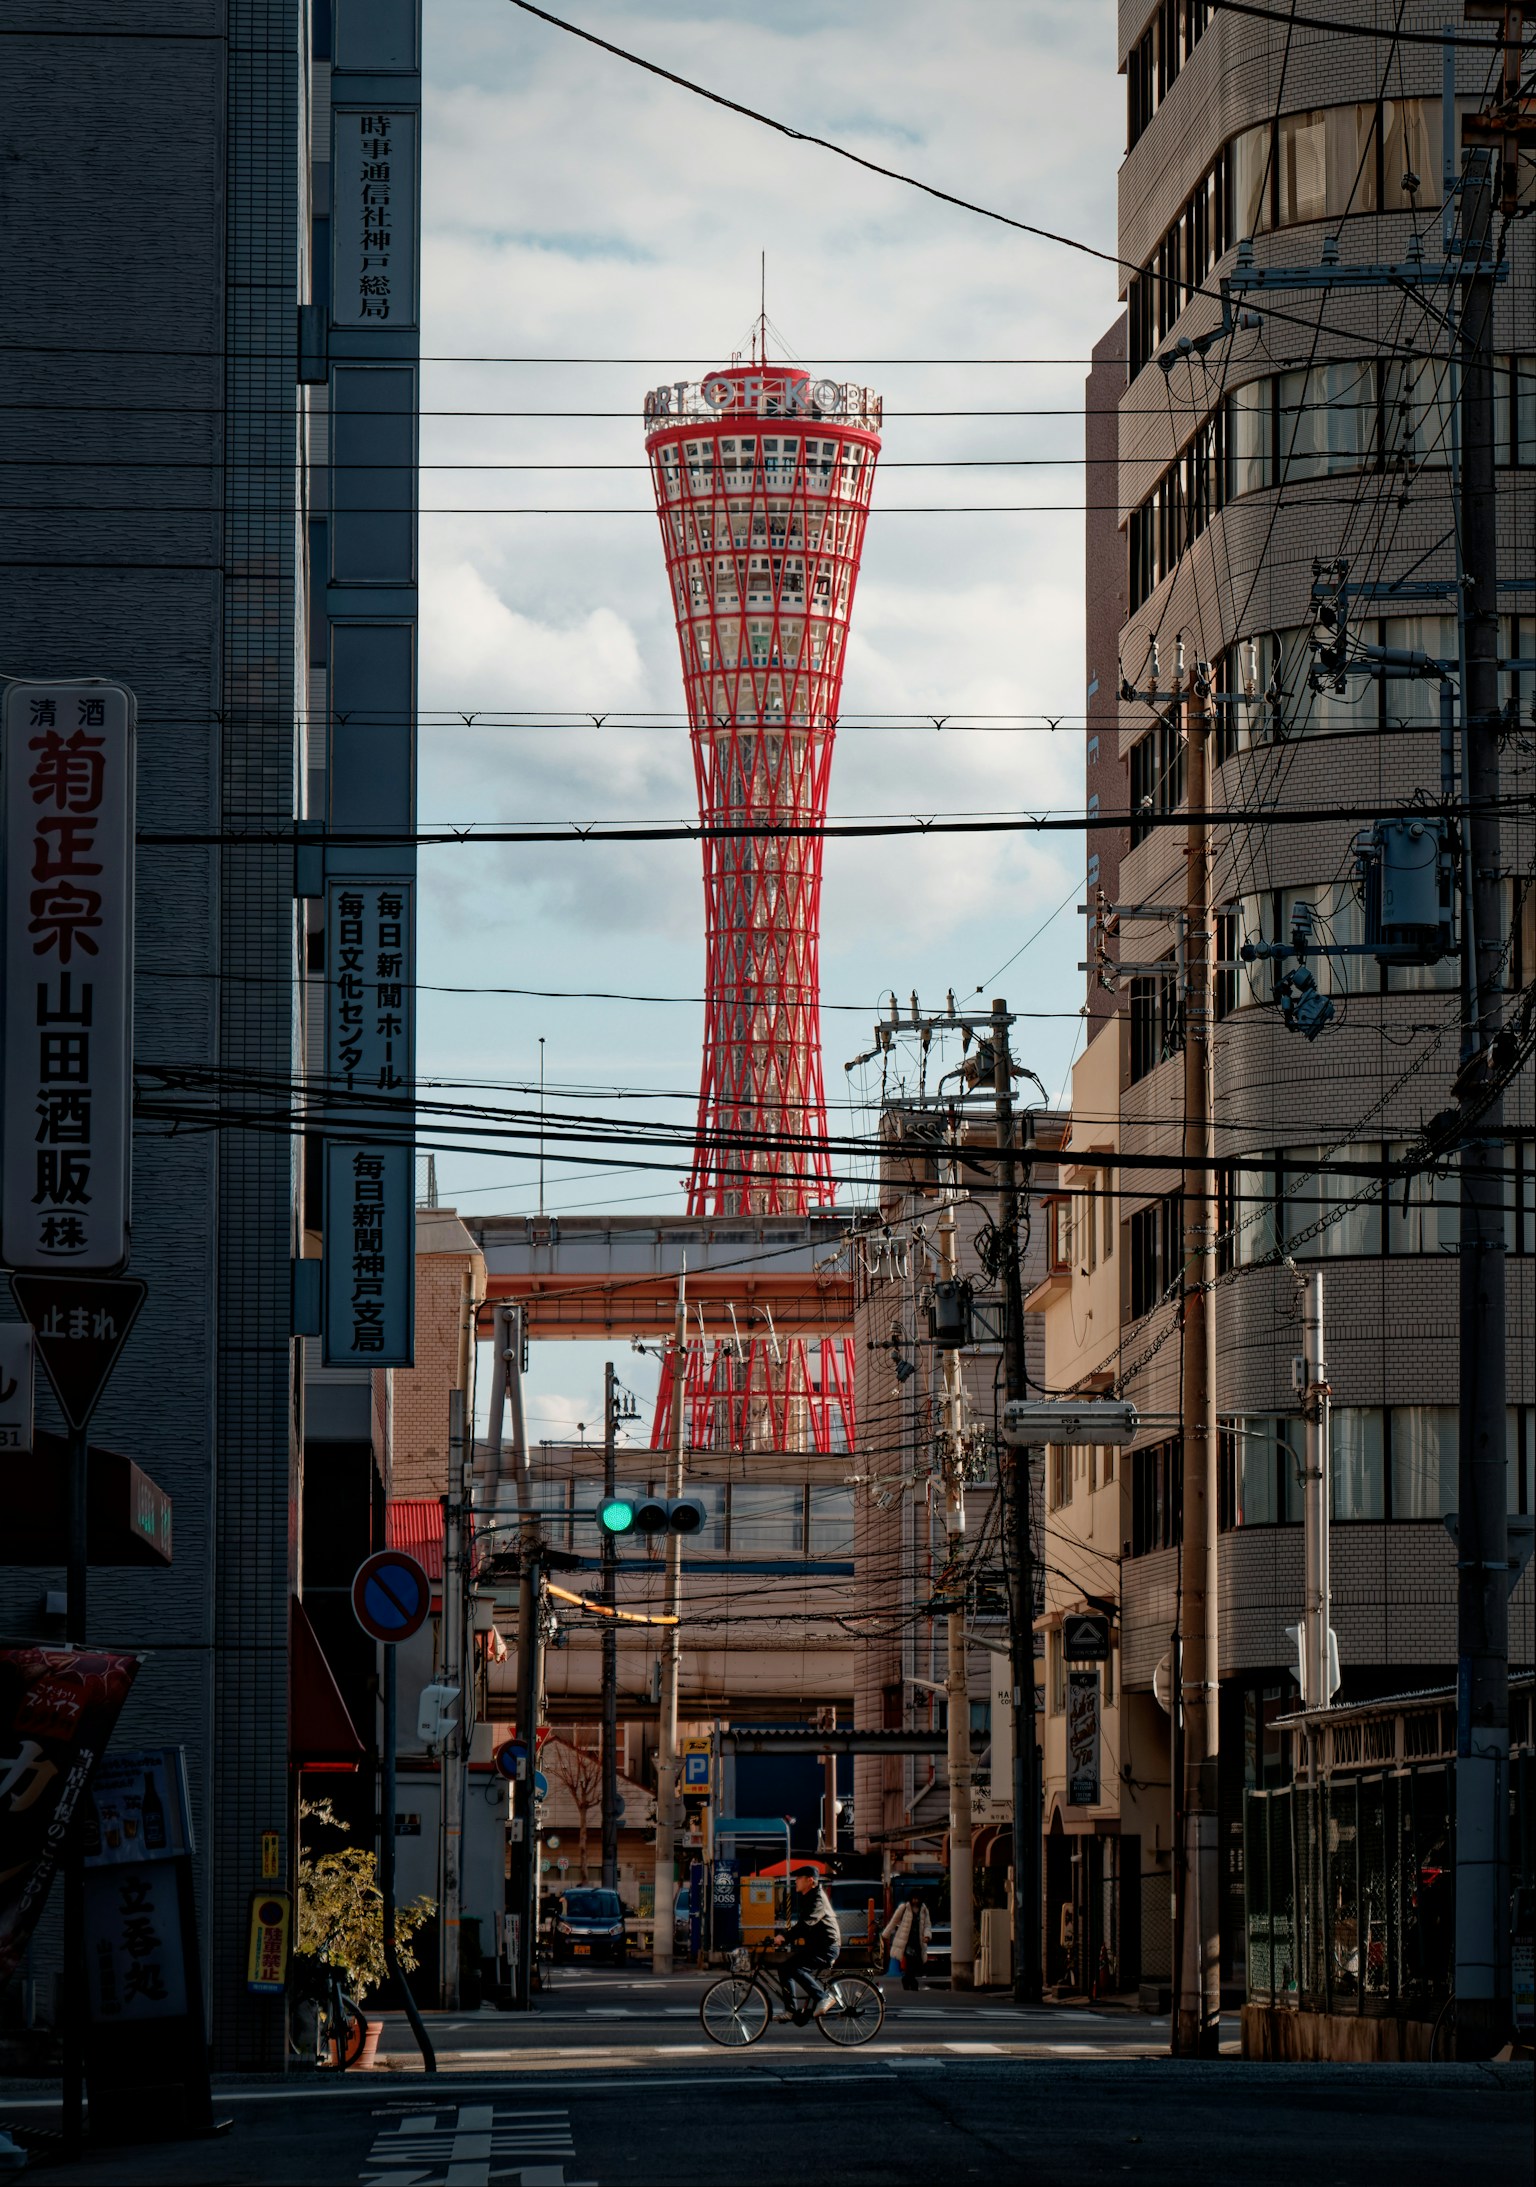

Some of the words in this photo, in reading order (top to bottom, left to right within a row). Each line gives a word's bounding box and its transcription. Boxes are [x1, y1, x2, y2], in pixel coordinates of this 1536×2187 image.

[359, 115, 392, 320] 時事通信社神戸総局
[644, 381, 688, 424] ORT
[704, 376, 763, 409] OF
[785, 377, 875, 420] KOBE
[29, 699, 105, 727] 清酒
[28, 729, 106, 964] 菊正宗
[338, 891, 364, 1090] 毎日文化センター
[376, 892, 403, 1089] 毎日新聞ホール
[350, 1152, 385, 1352] 毎日新聞神戸支局
[39, 1304, 118, 1341] 止まれ
[689, 1758, 706, 1781] P
[118, 1876, 169, 2003] 立呑処
[713, 1894, 735, 1903] BOSS
[261, 1927, 283, 1980] 駐車禁止
